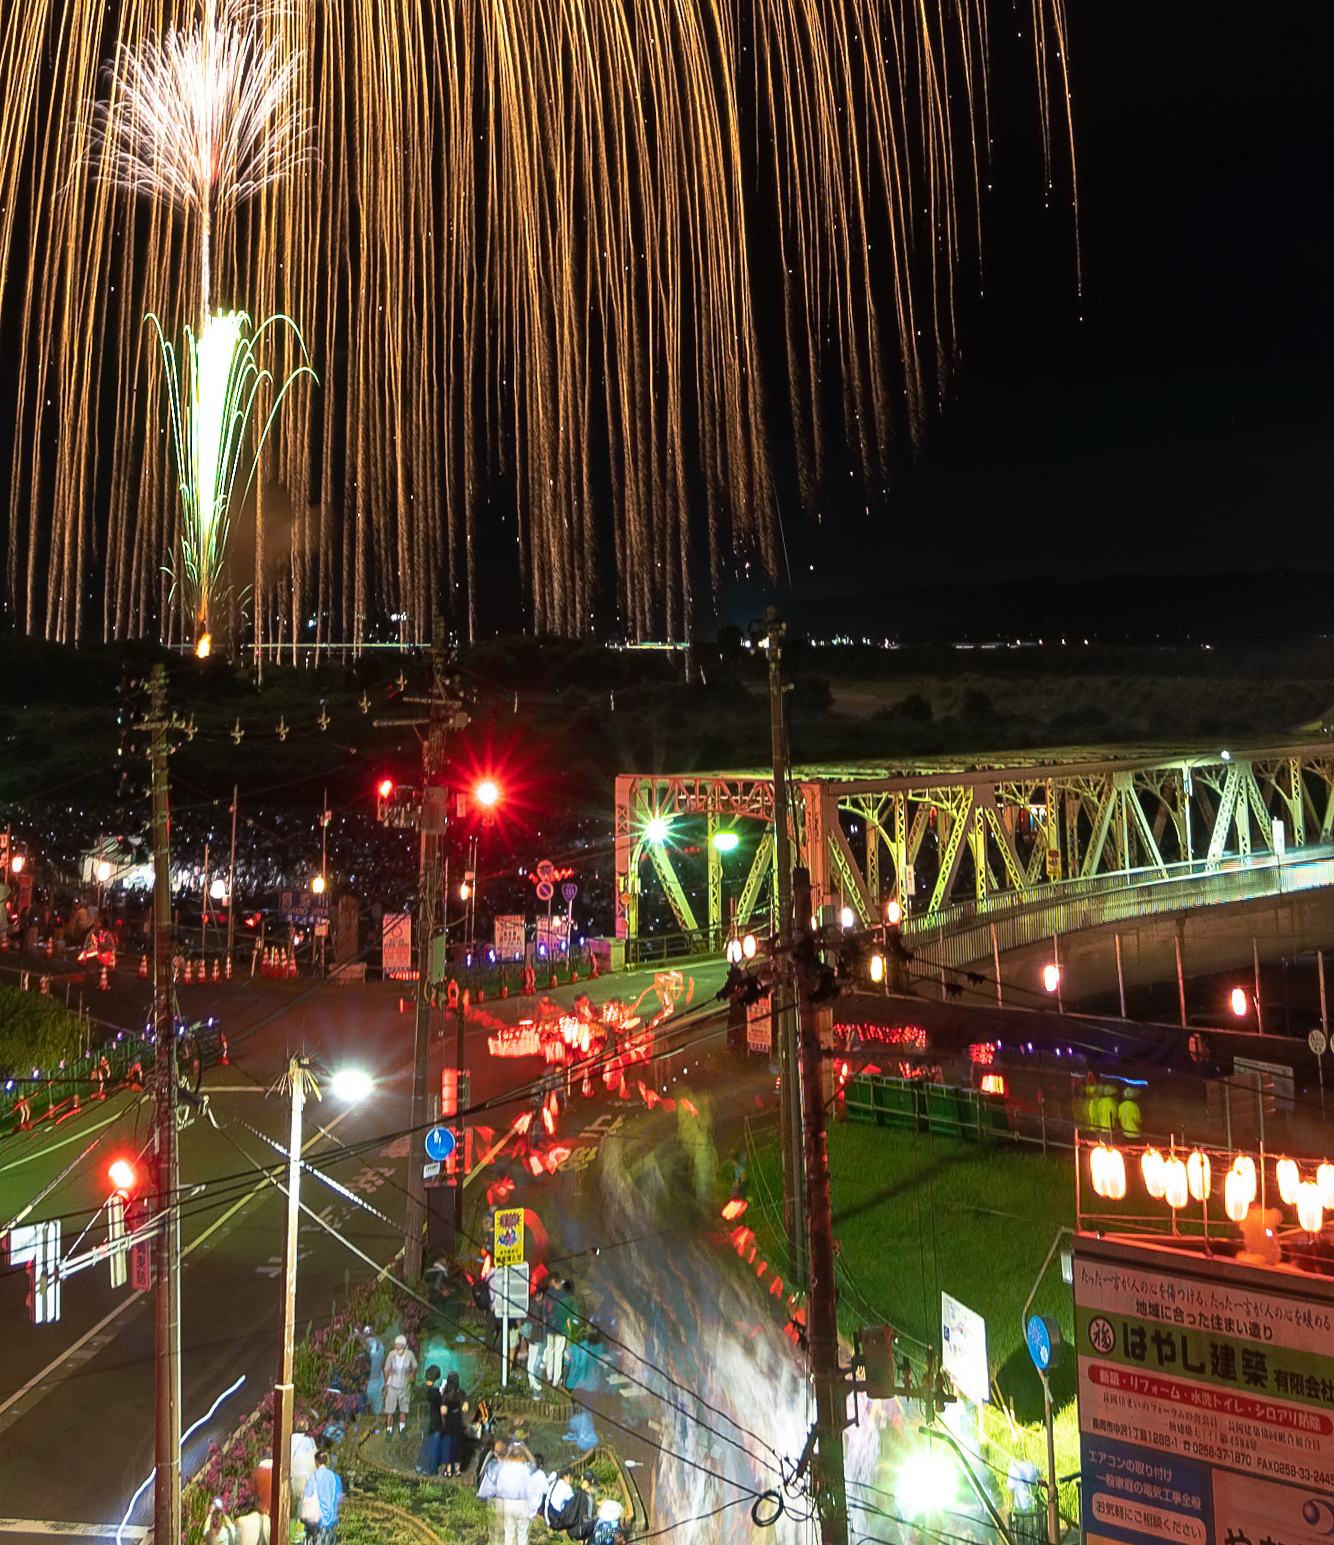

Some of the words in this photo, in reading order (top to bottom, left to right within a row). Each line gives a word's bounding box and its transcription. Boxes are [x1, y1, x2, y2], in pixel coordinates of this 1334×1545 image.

[1122, 1322, 1269, 1389] はやし建築
[1089, 1449, 1173, 1482] エアコンの取り付け
[1096, 1472, 1202, 1510] 一般家庭の電気工事全般
[1096, 1499, 1202, 1539] お気軽にご相談ください
